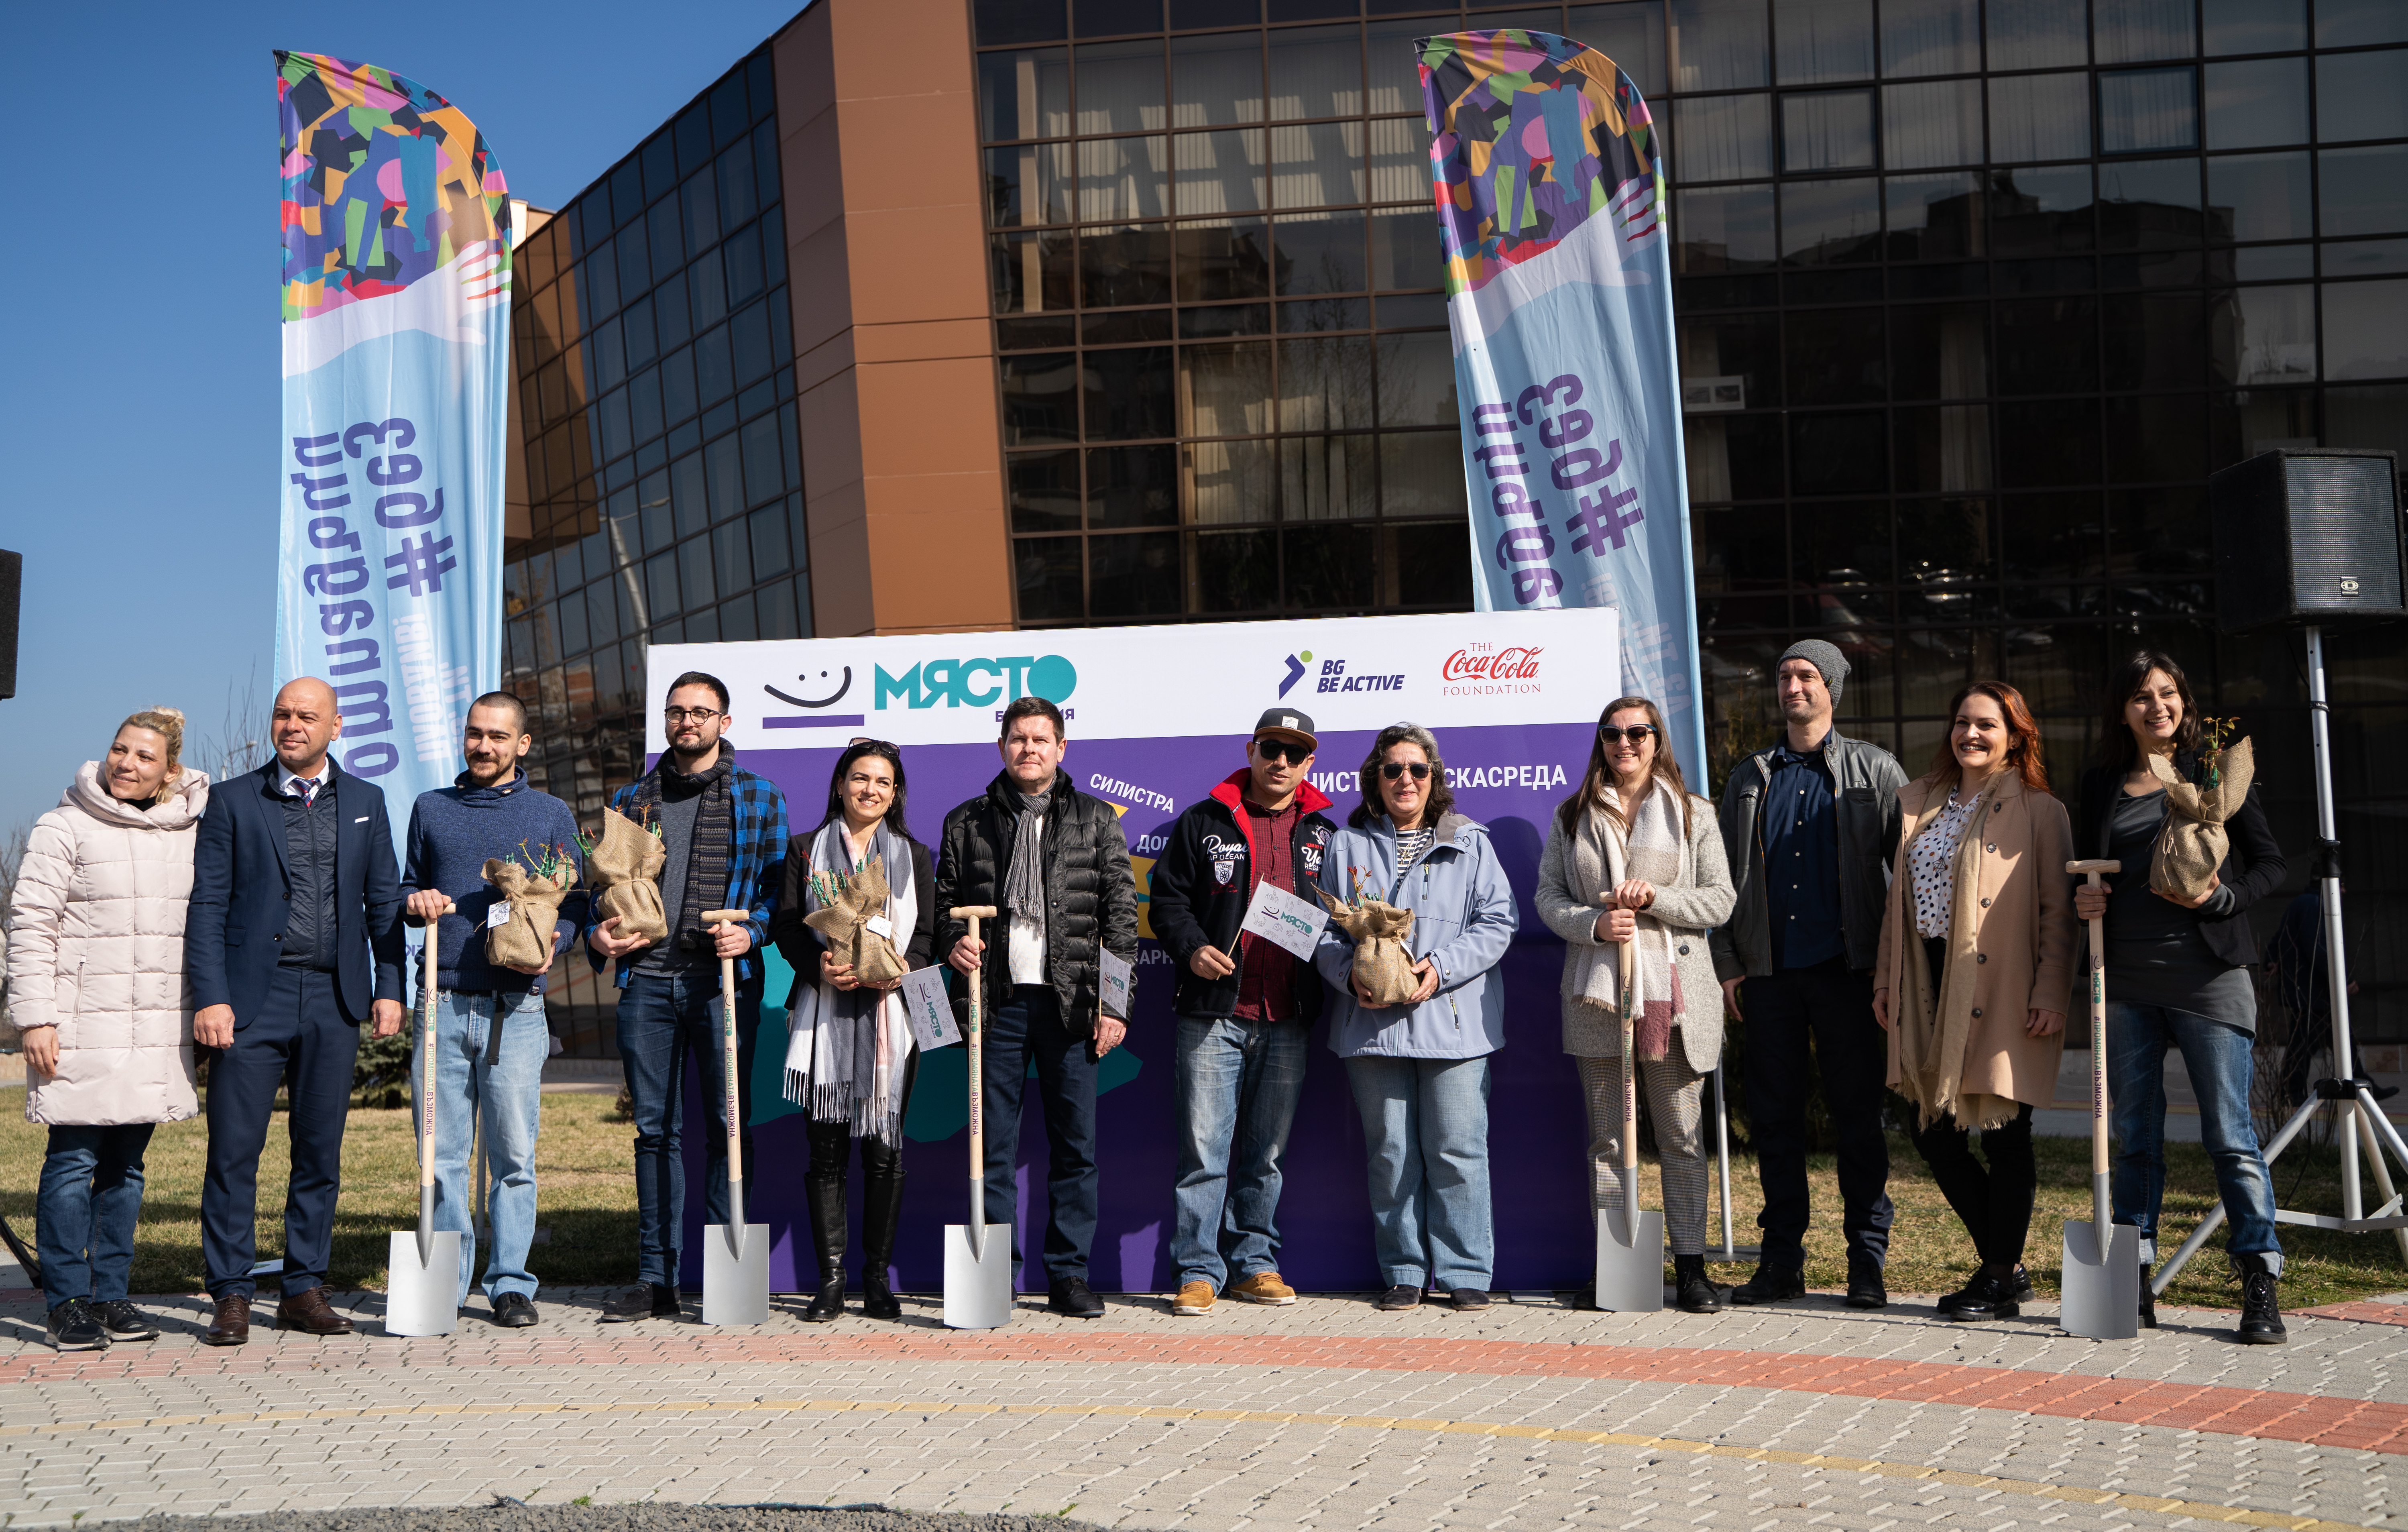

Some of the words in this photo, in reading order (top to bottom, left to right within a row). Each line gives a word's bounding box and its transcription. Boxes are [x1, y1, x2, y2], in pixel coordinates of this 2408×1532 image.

[1470, 642, 1493, 651] THE
[875, 655, 1077, 710] МЯСТО
[1317, 677, 1340, 693] BE
[1341, 674, 1405, 691] ACTIVE
[1321, 659, 1345, 676] BG
[1443, 683, 1541, 696] FOUNDATION
[1090, 773, 1174, 814] СИЛИСТРА
[1280, 911, 1313, 934] МЯСТО
[1138, 949, 1176, 965] АРН
[1111, 974, 1125, 991] МЯСТО
[2092, 972, 2101, 1004] МЯСТО
[926, 1001, 942, 1038] МЯСТО
[1623, 1030, 1632, 1122] #ПРОМЯНАТАВЪЗМОЖНА
[2093, 1016, 2102, 1118] #ПРОМЯНАТАВЪЗМОЖНА
[425, 1043, 435, 1135] #ПРОМЯНАТАВЪЗМОЖНА
[726, 1047, 735, 1138] #ПРОМЯНАТАВЪЗМОЖНА
